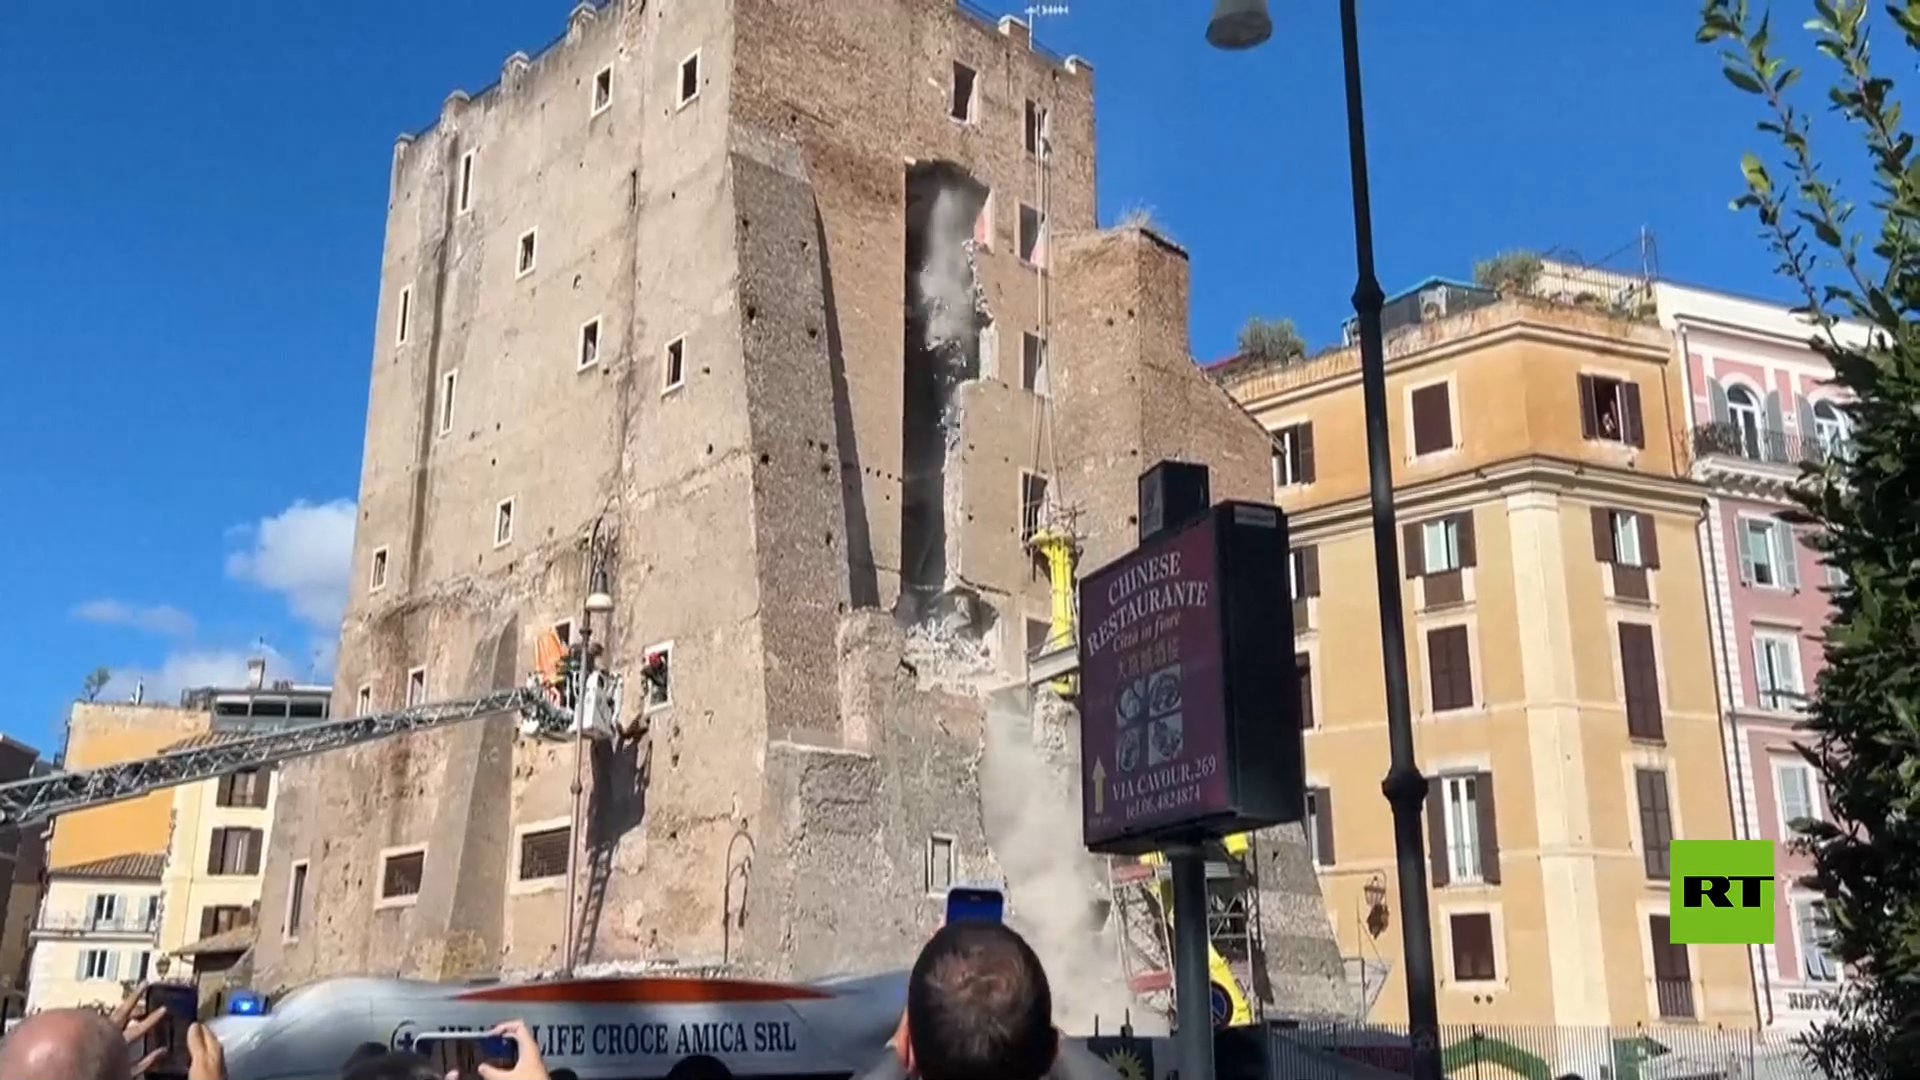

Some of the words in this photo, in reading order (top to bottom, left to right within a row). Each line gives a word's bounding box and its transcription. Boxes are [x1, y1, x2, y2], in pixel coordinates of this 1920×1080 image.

[1108, 551, 1181, 605] CHINESE
[1087, 581, 1208, 657] RESTAURANTE
[1112, 779, 1134, 800] VIA
[532, 1025, 585, 1057] LIFE
[592, 1023, 669, 1055] CROCE
[675, 1023, 749, 1054] AMICA
[753, 1022, 797, 1051] SRL
